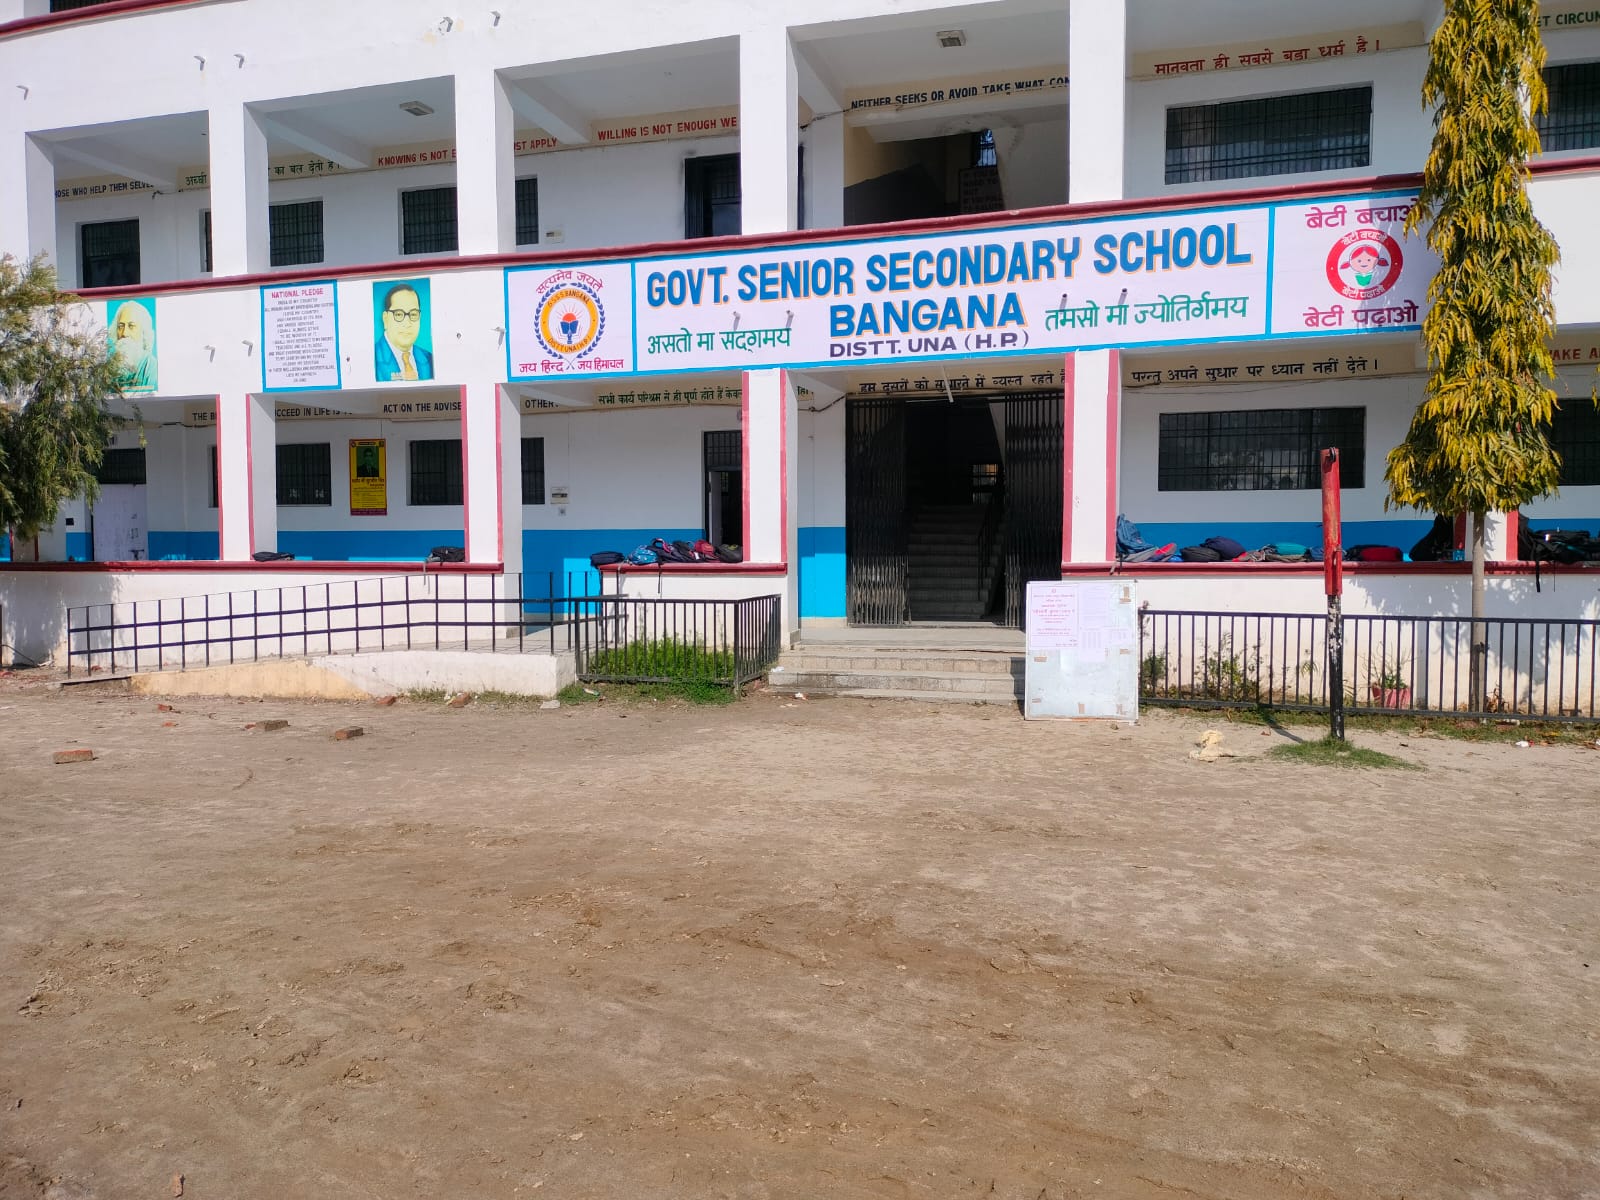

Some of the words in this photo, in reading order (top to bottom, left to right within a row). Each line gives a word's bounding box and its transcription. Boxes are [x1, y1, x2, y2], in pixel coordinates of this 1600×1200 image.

[1535, 15, 1551, 27] ET
[1154, 59, 1206, 75] मानवता
[1212, 53, 1230, 69] ही
[1238, 48, 1274, 65] सबसे
[1318, 39, 1346, 57] धर्म
[851, 96, 892, 110] NEITHER
[895, 93, 928, 105] SEEKS
[931, 90, 945, 101] OR
[949, 86, 978, 99] AVOID
[982, 82, 1011, 95] TAKE
[1015, 79, 1045, 93] WHAT
[597, 127, 637, 141] WILLING
[640, 126, 650, 137] IS
[652, 123, 673, 136] NOT
[677, 119, 717, 133] ENOUGH
[720, 116, 738, 128] WE
[514, 141, 527, 151] ST
[530, 136, 558, 150] APPLY
[378, 151, 417, 167] KNOWING
[419, 152, 428, 162] IS
[430, 149, 449, 161] NOT
[72, 187, 88, 196] WHO
[90, 184, 107, 195] HELP
[109, 182, 128, 192] THEM
[1304, 204, 1348, 229] बेटी
[647, 266, 730, 308] GOVT.
[737, 256, 856, 303] SENIOR
[866, 235, 1082, 293] SECONDARY
[1092, 222, 1253, 276] SCHOOL
[271, 290, 300, 299] NATIONAL
[301, 287, 324, 297] PLEDGE
[536, 269, 573, 294] सत्यमेव
[576, 271, 604, 292] जयते
[830, 290, 1029, 338] BANGANA
[1044, 300, 1101, 332] तमसो
[1105, 303, 1129, 326] मा
[1134, 291, 1250, 325] ज्योतिर्गमय
[1303, 304, 1345, 328] बेटी
[647, 327, 693, 355] असतो
[697, 330, 716, 352] मा
[829, 340, 902, 359] DISTT.
[908, 335, 957, 354] UNA
[519, 362, 538, 373] जय
[541, 359, 564, 373] हिन्द
[577, 360, 592, 371] जय
[593, 357, 624, 371] हिमाचल
[1550, 348, 1582, 361] AKE
[859, 382, 877, 393] हम
[914, 376, 930, 391] को
[935, 374, 970, 393] सुारते
[992, 375, 1024, 387] व्यस्त
[1031, 370, 1055, 385] रहते
[1131, 370, 1162, 385] परन्तु
[1167, 365, 1199, 380] अपने
[1205, 366, 1239, 382] सुधार
[1246, 365, 1265, 378] पर
[1271, 362, 1305, 376] ध्यान
[1313, 357, 1339, 374] नहीं
[1346, 356, 1369, 374] देते
[275, 408, 301, 417] CCEED
[303, 407, 312, 417] IN
[313, 407, 331, 416] LIFE
[383, 403, 398, 414] ACT
[400, 403, 413, 413] ON
[415, 402, 432, 412] THE
[433, 401, 462, 411] ADVISE
[525, 398, 560, 409] OTHER
[191, 411, 208, 421] THE
